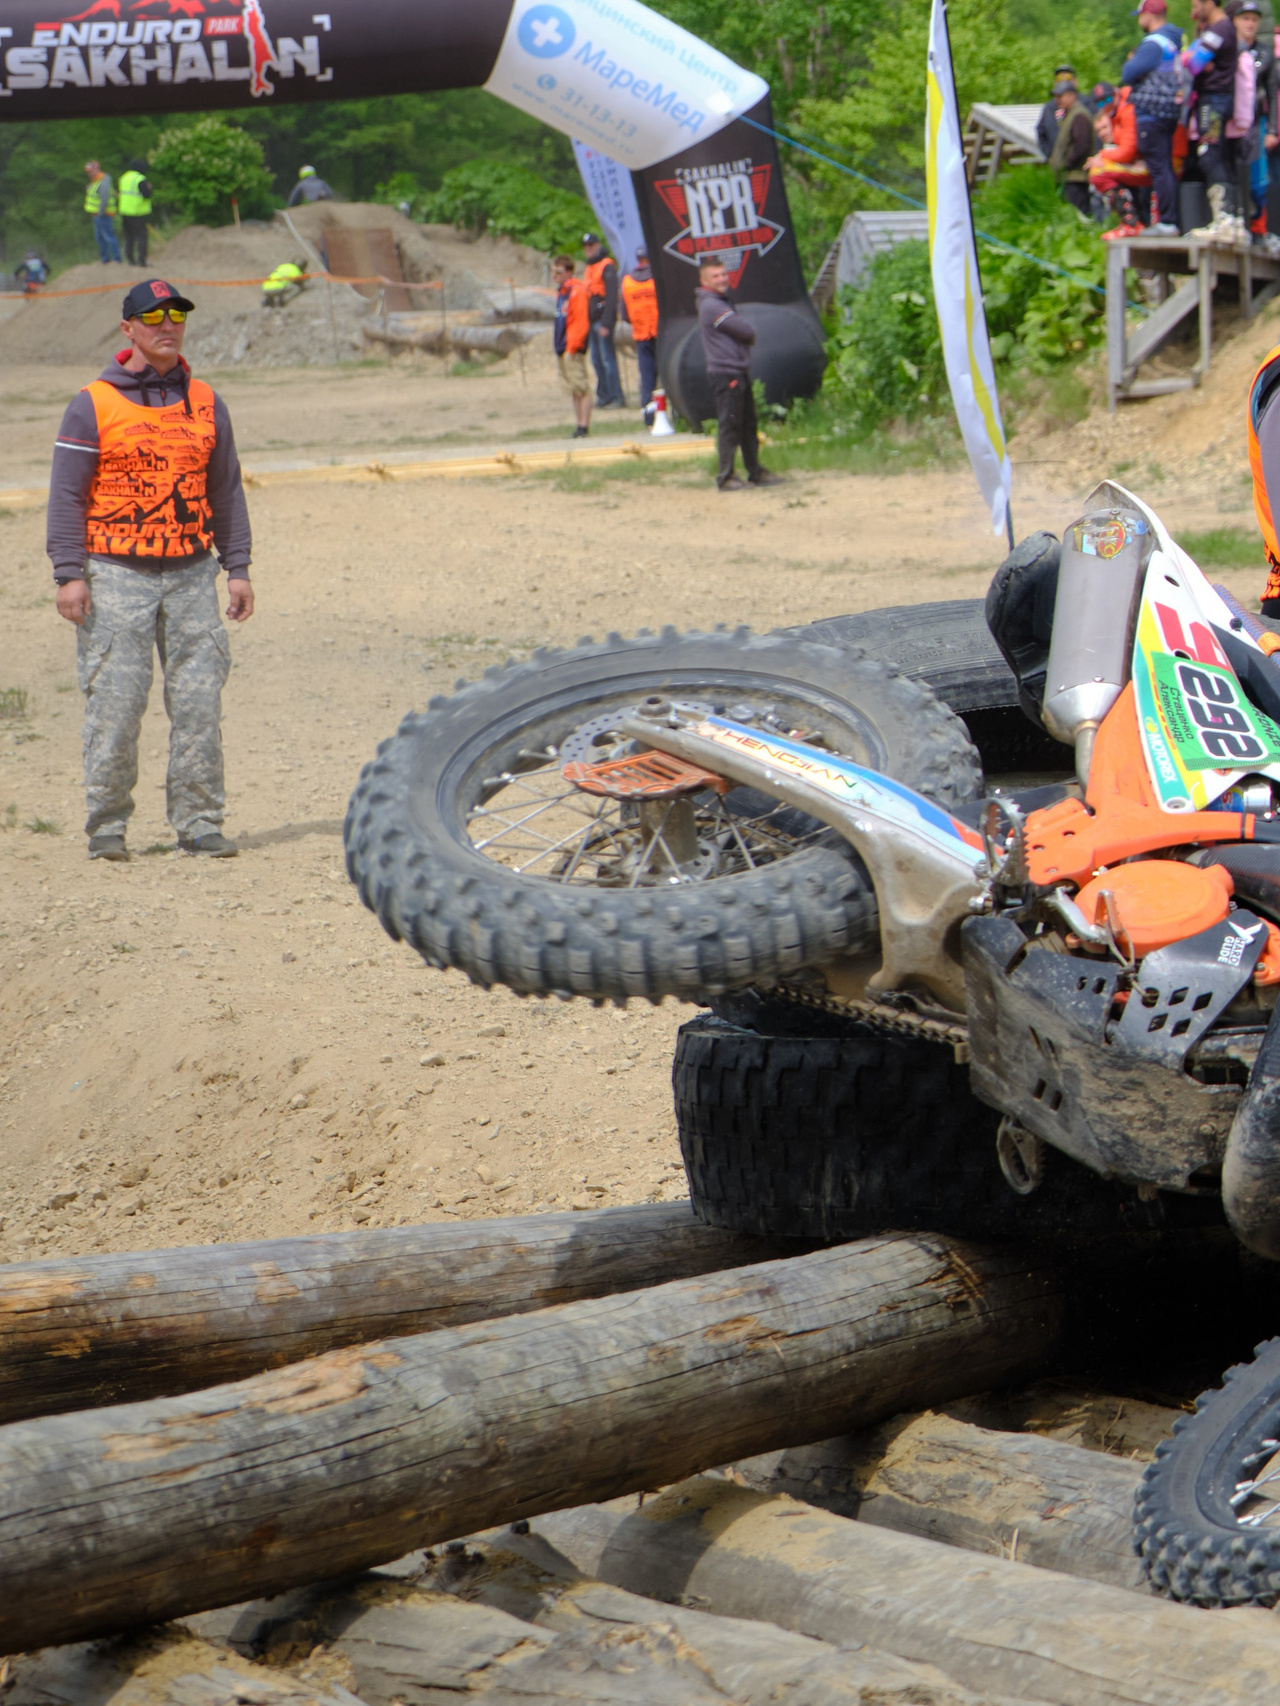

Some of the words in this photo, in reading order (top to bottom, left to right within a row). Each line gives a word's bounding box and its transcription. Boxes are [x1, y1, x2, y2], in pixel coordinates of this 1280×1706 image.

[32, 18, 203, 47] ENDURO
[207, 17, 240, 33] PARK
[573, 40, 706, 133] МареМед
[681, 159, 748, 184] SAKHALIN
[87, 520, 184, 538] ENDURO
[1159, 679, 1184, 743] Александр
[1169, 687, 1194, 740] Стаценко
[1178, 664, 1266, 760] 292
[1147, 730, 1178, 783] MOTOREX
[1217, 935, 1235, 963] GLIDE
[1229, 937, 1247, 966] HARD
